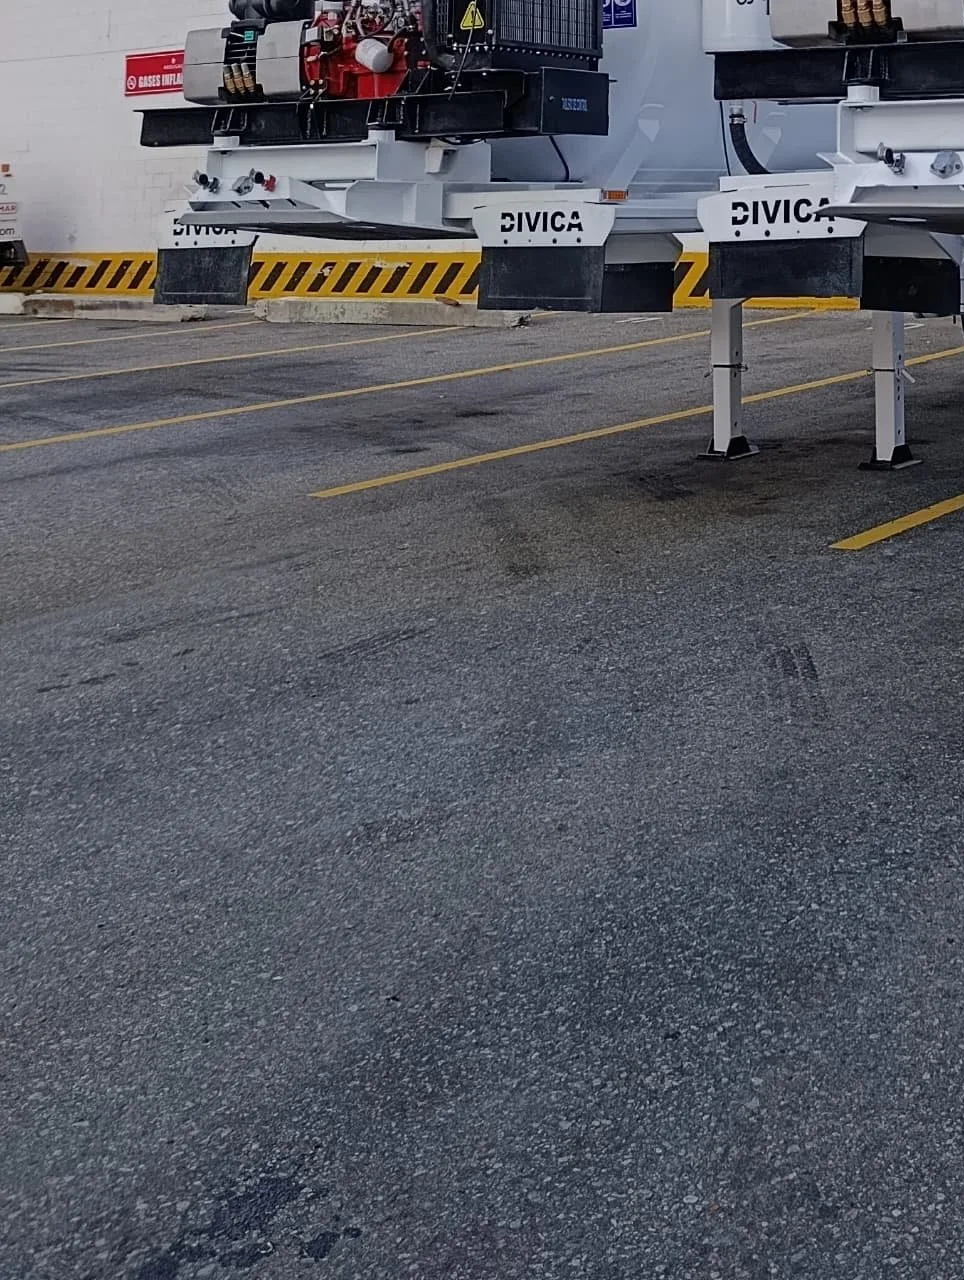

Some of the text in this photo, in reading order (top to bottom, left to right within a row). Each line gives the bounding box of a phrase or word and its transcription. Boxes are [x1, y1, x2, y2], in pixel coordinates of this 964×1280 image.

[138, 72, 184, 88] GASES INFLA
[501, 211, 584, 232] DIVICA
[732, 198, 836, 225] DIVICA
